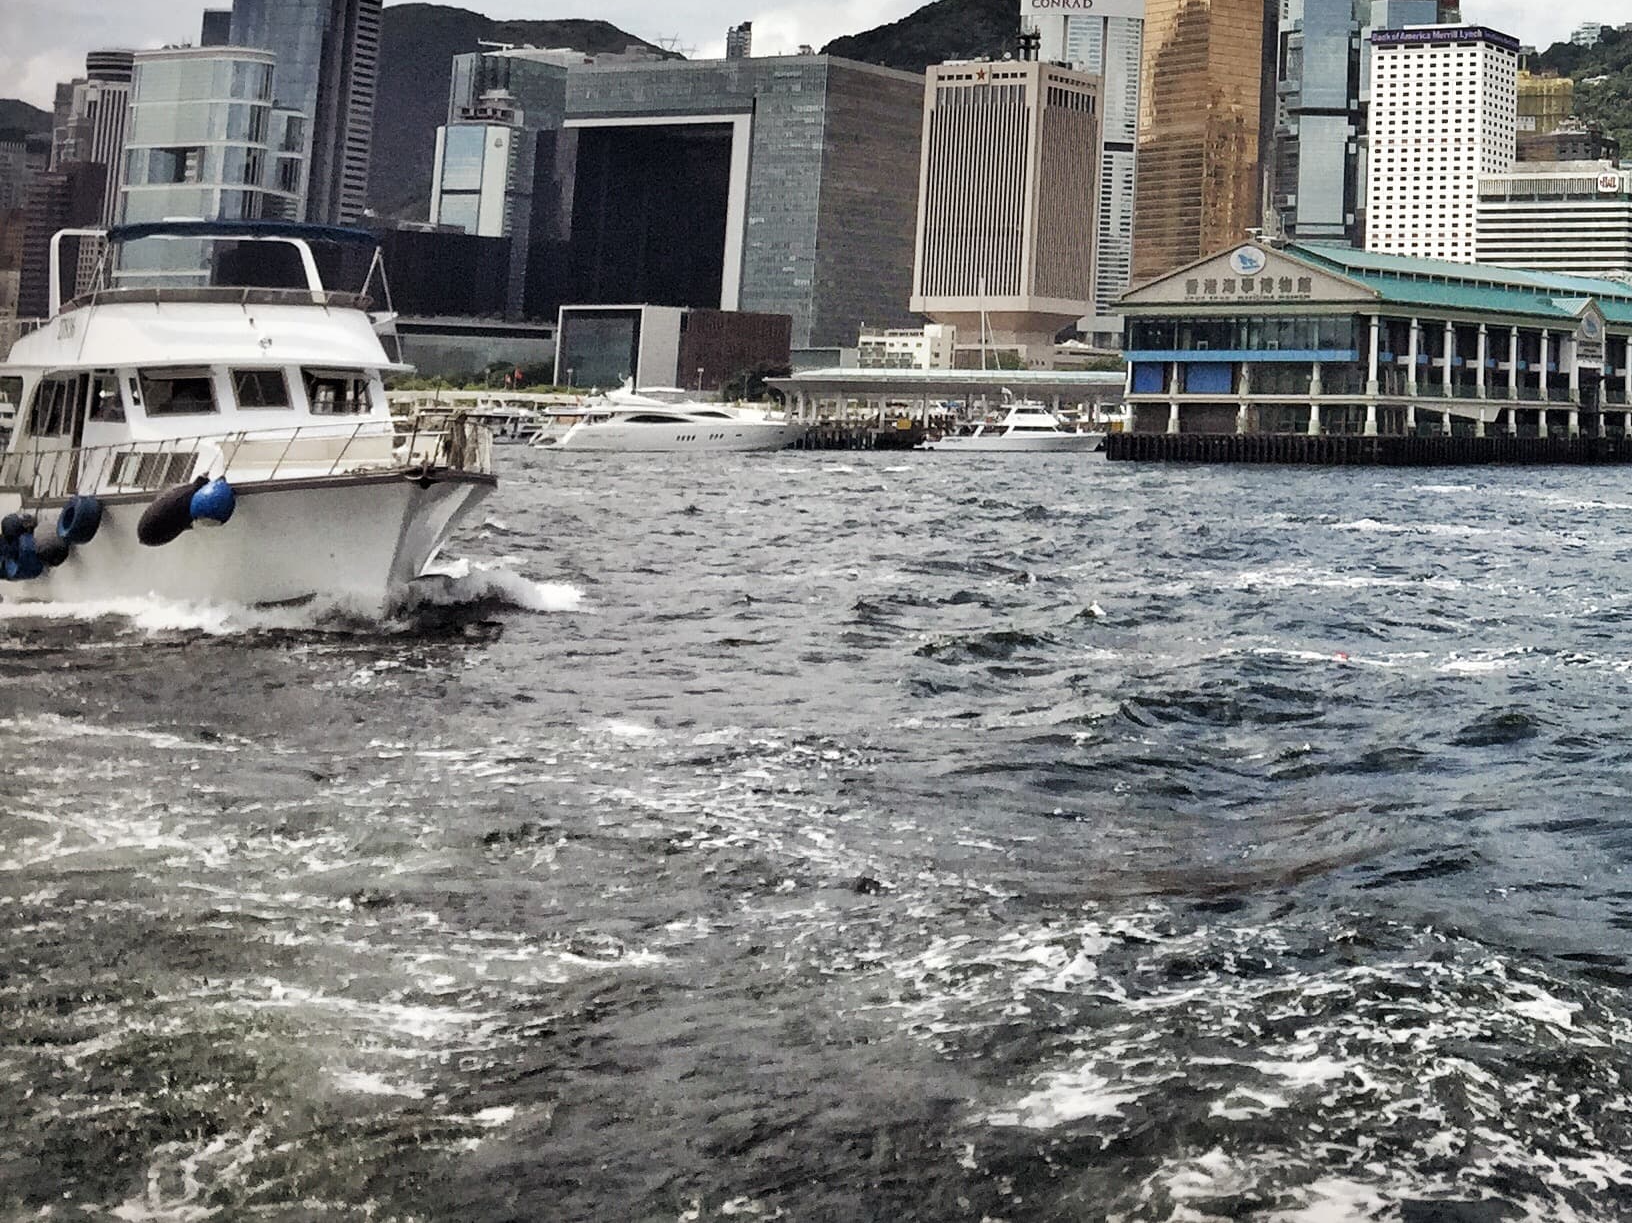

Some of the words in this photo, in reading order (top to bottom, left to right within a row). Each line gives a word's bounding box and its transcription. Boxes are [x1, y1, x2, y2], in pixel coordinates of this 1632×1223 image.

[1400, 32, 1431, 41] America
[1432, 30, 1458, 40] Merrill
[1459, 28, 1483, 41] Lynch
